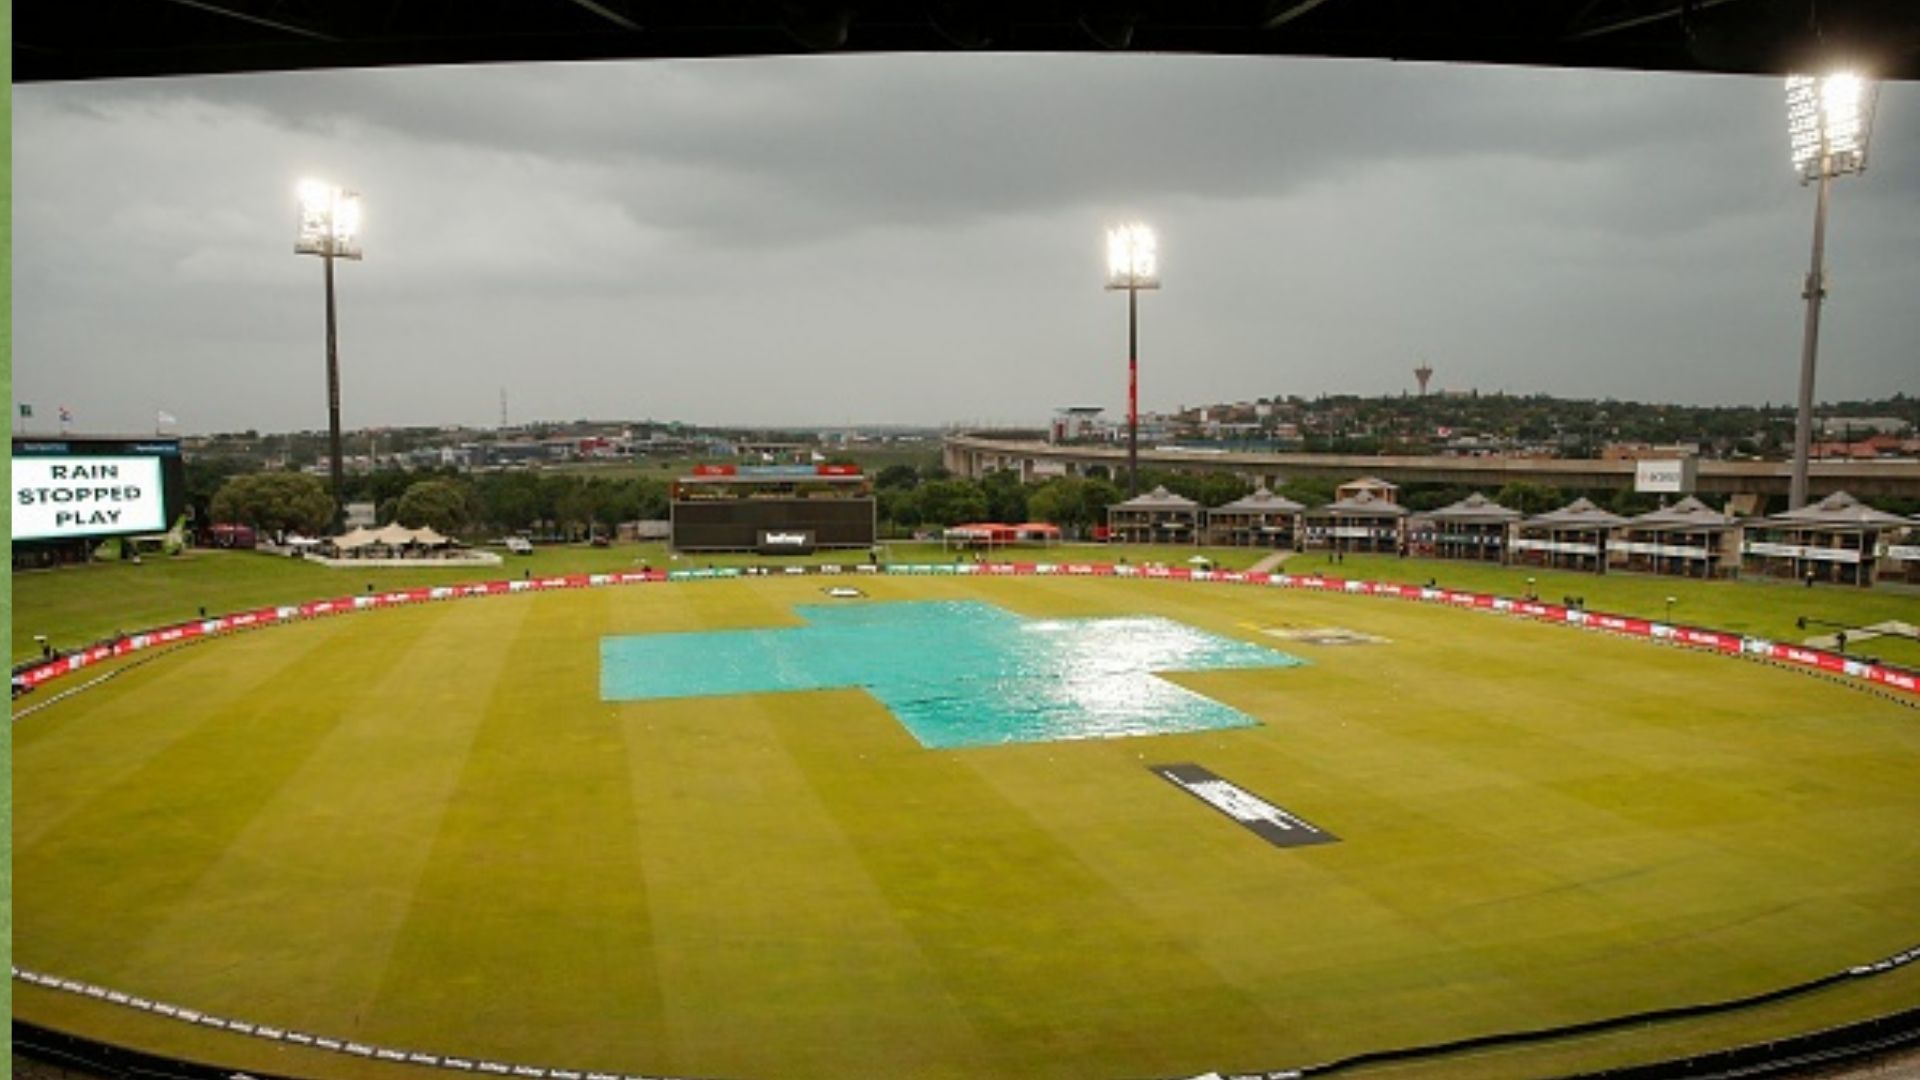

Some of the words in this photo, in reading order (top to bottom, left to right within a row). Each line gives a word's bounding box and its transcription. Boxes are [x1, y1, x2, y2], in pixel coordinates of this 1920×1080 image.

[51, 465, 119, 479] RAIN
[17, 485, 142, 505] STOPPED
[55, 510, 121, 526] PLAY
